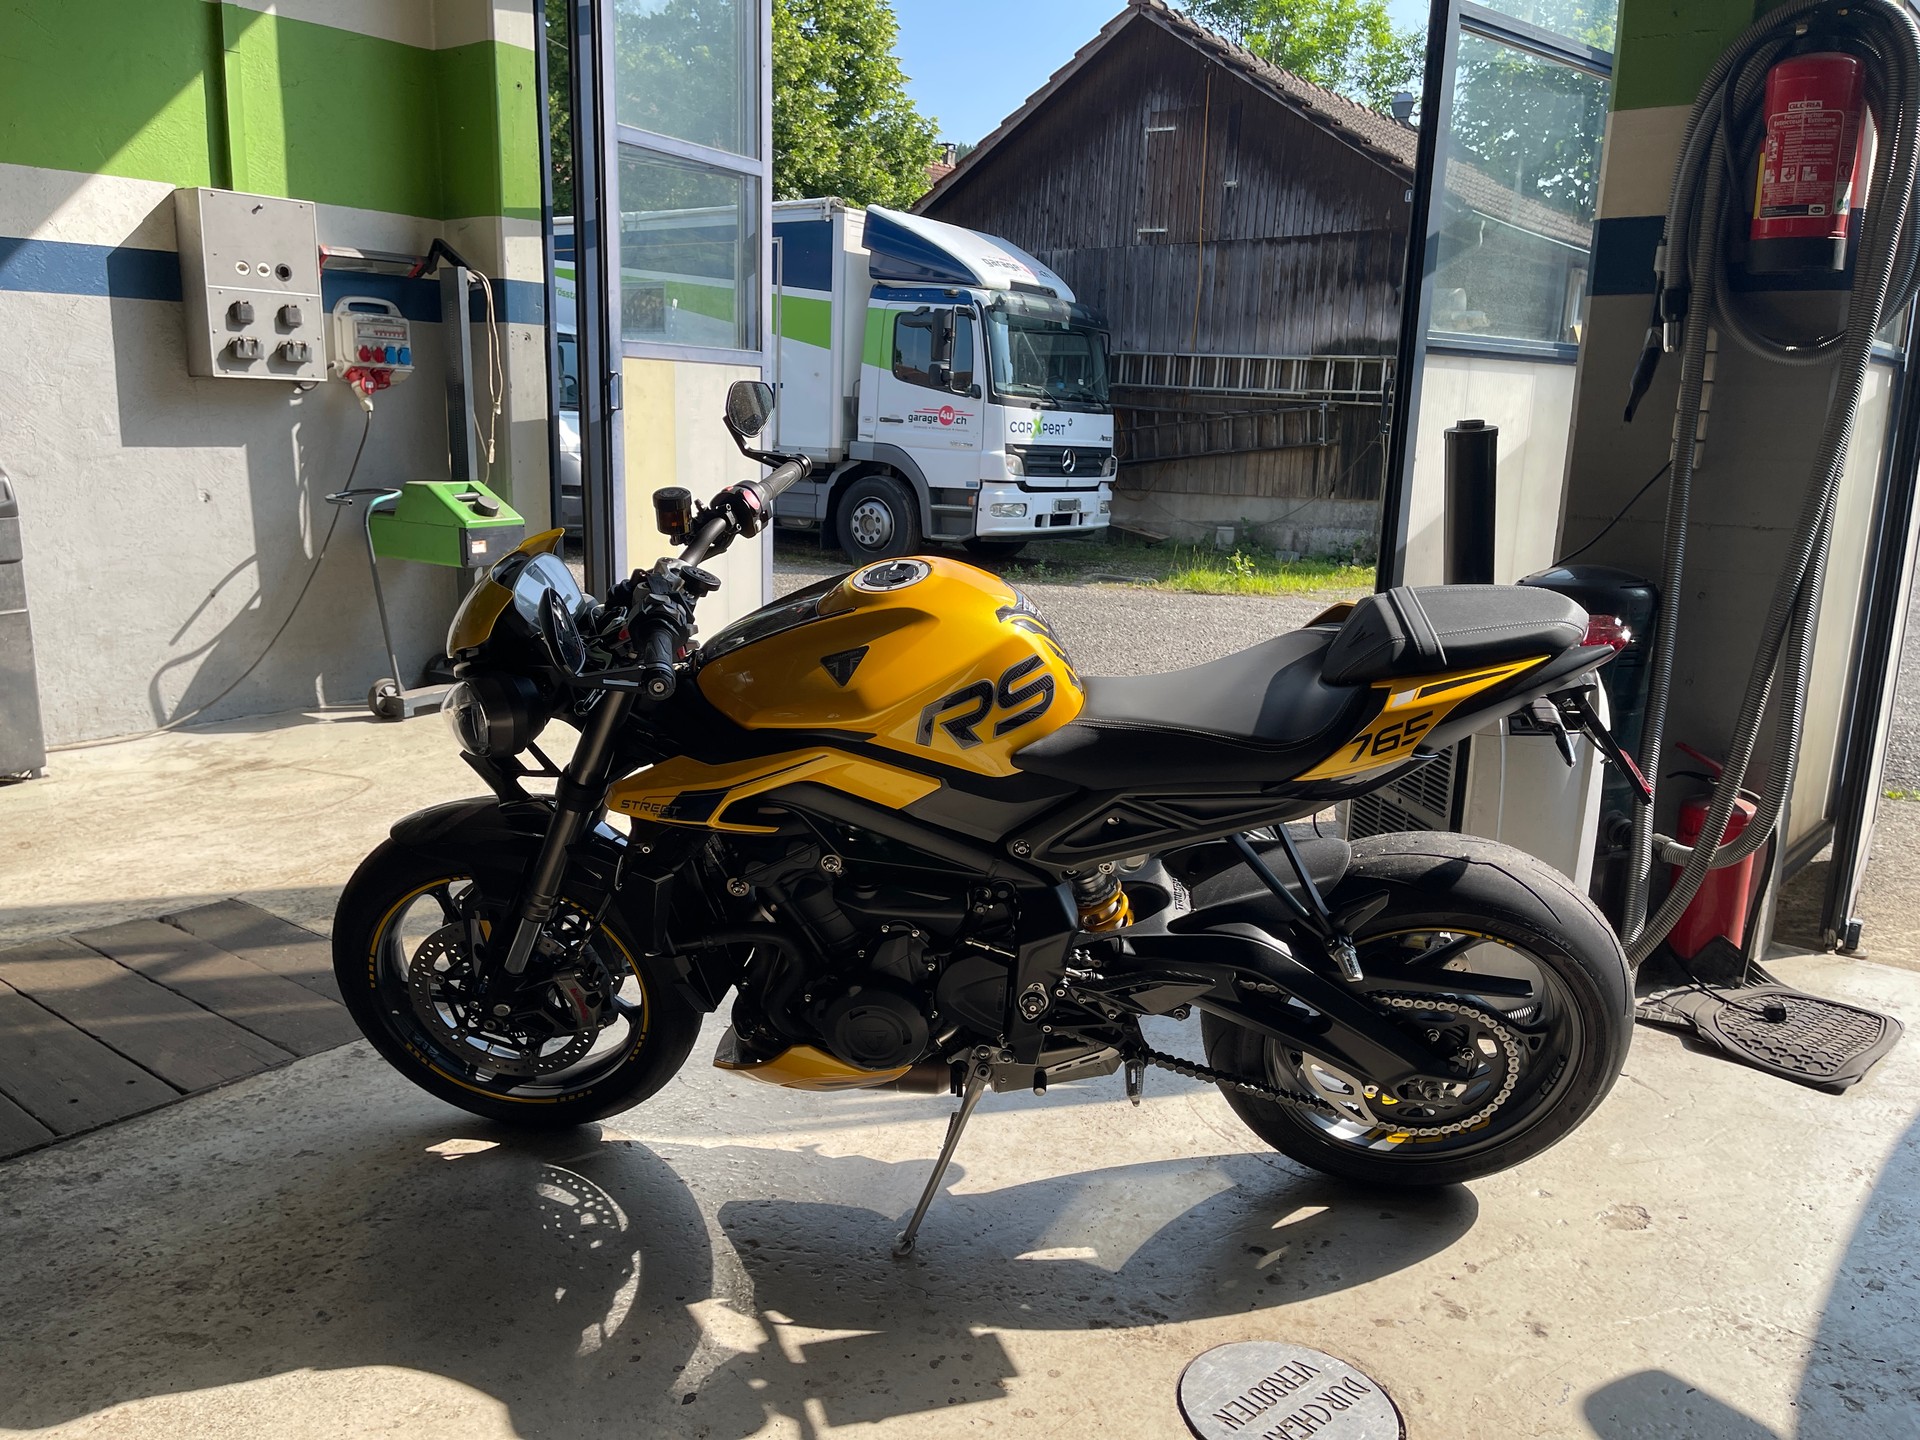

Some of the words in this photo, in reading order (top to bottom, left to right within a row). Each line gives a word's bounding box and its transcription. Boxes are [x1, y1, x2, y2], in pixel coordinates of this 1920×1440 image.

[916, 653, 1056, 750] RS
[1350, 710, 1434, 763] 765
[620, 799, 682, 816] STREET
[1212, 1360, 1321, 1431] VERBOTEN
[1262, 1376, 1372, 1440] DURCHGA
